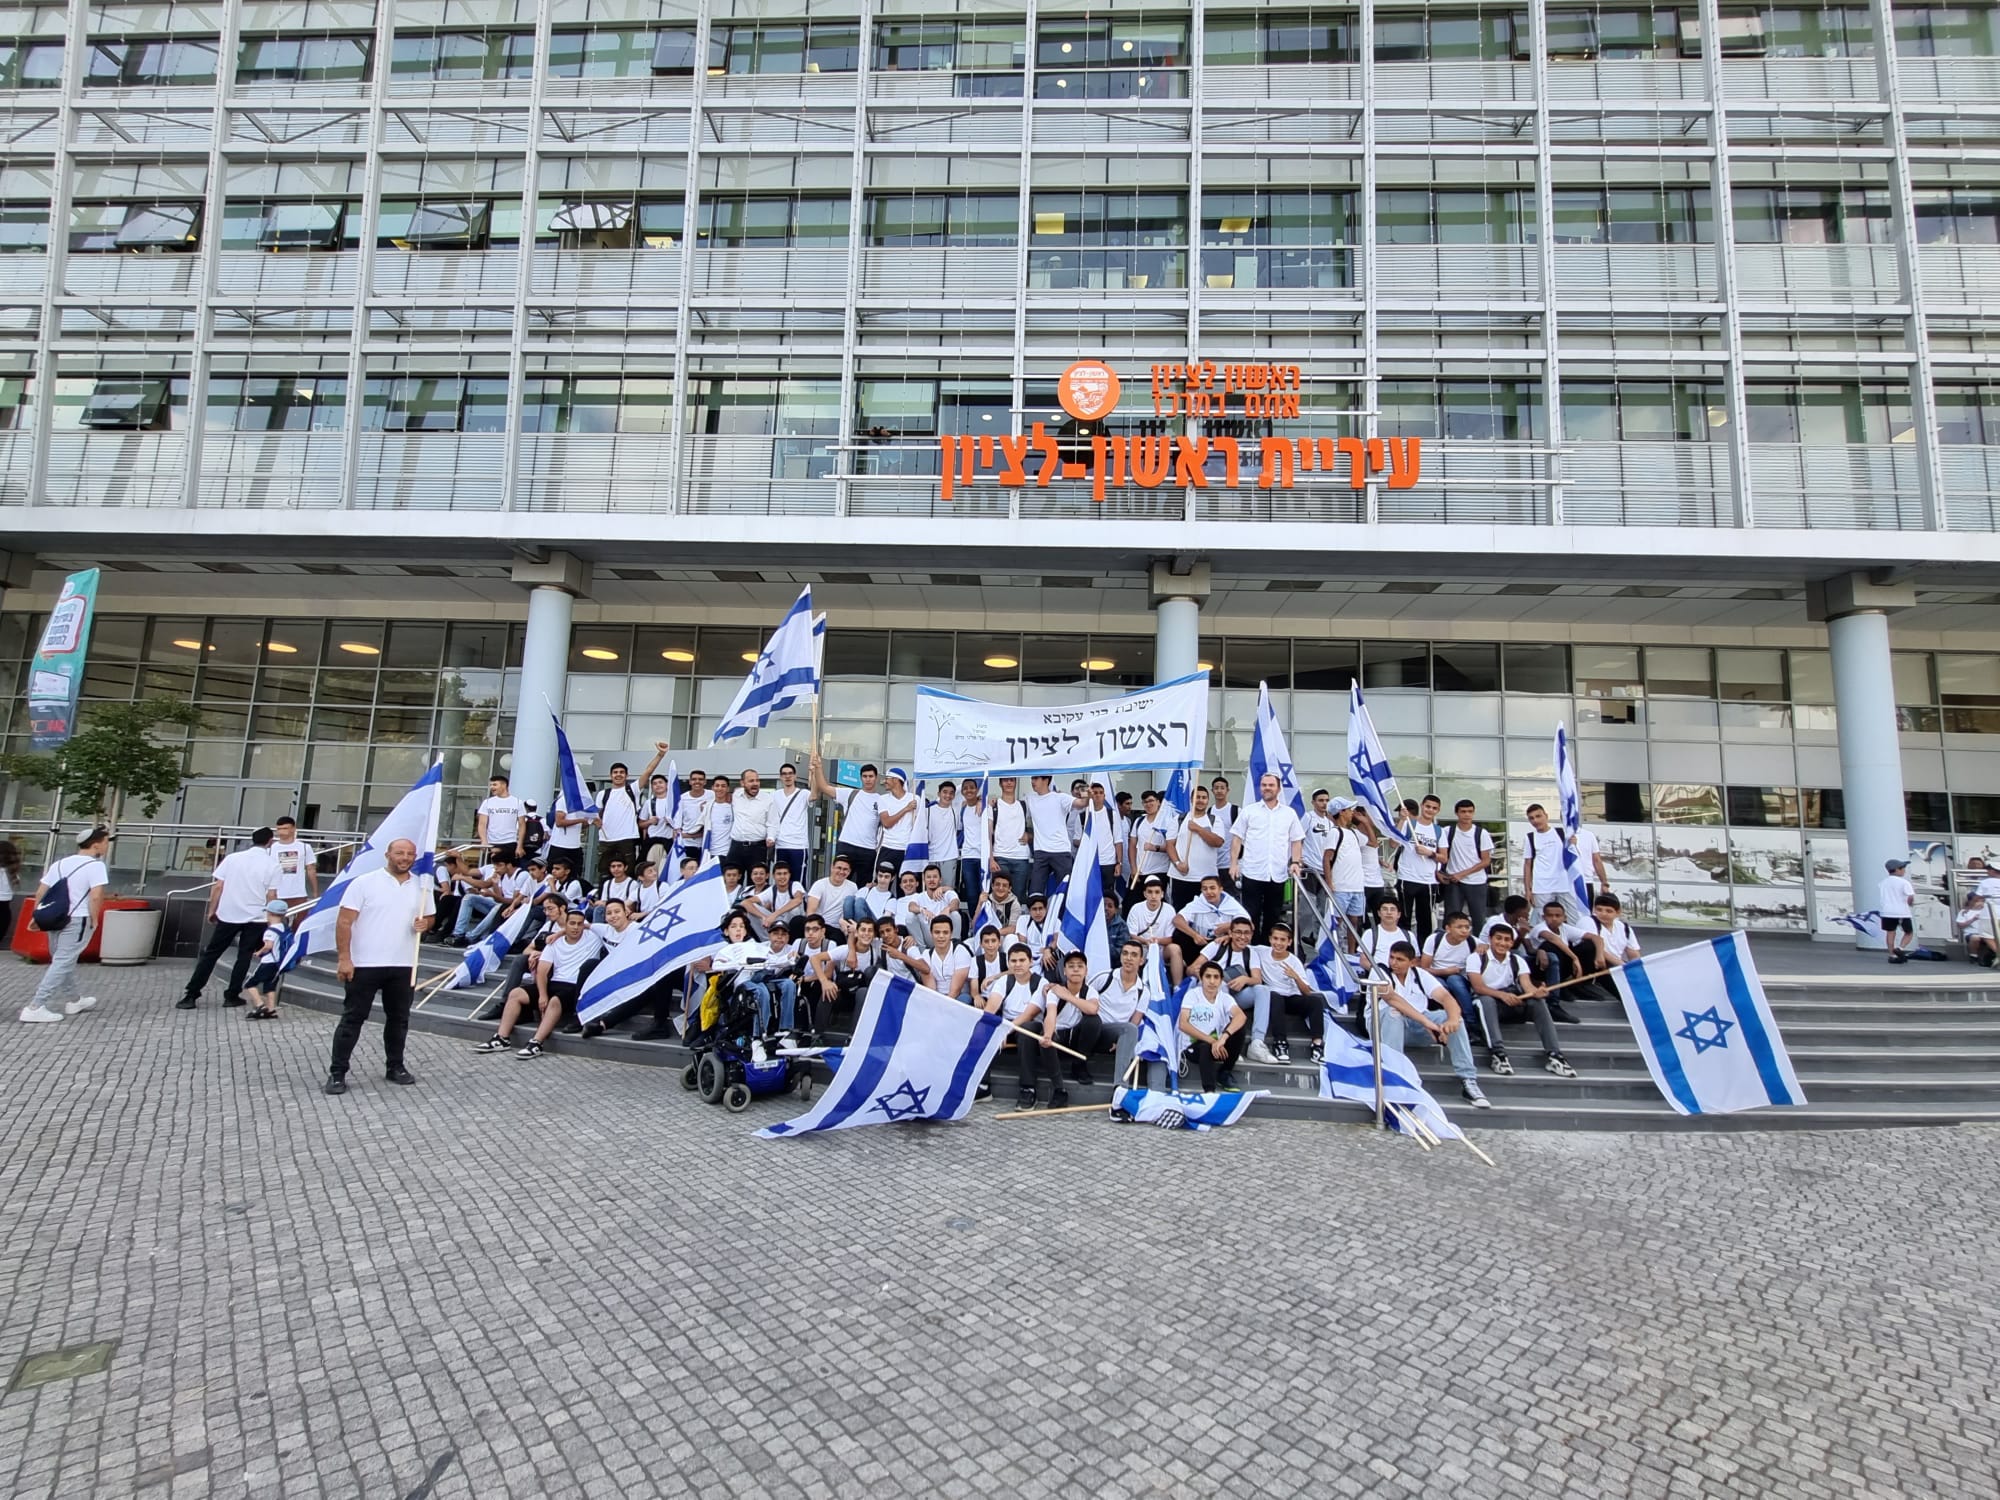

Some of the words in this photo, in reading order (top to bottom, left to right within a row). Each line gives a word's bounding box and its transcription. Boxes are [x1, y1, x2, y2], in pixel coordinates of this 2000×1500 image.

[1151, 360, 1217, 393] לציון
[1224, 364, 1300, 394] ראשון
[1151, 392, 1227, 418] במרכז
[1244, 393, 1300, 419] אתם
[1258, 437, 1420, 489] עיריית
[1043, 712, 1084, 724] עקיבא
[1090, 708, 1109, 717] בני
[1115, 699, 1154, 714] ישיבת
[1005, 728, 1080, 764] לציון
[1096, 721, 1188, 759] ראשון
